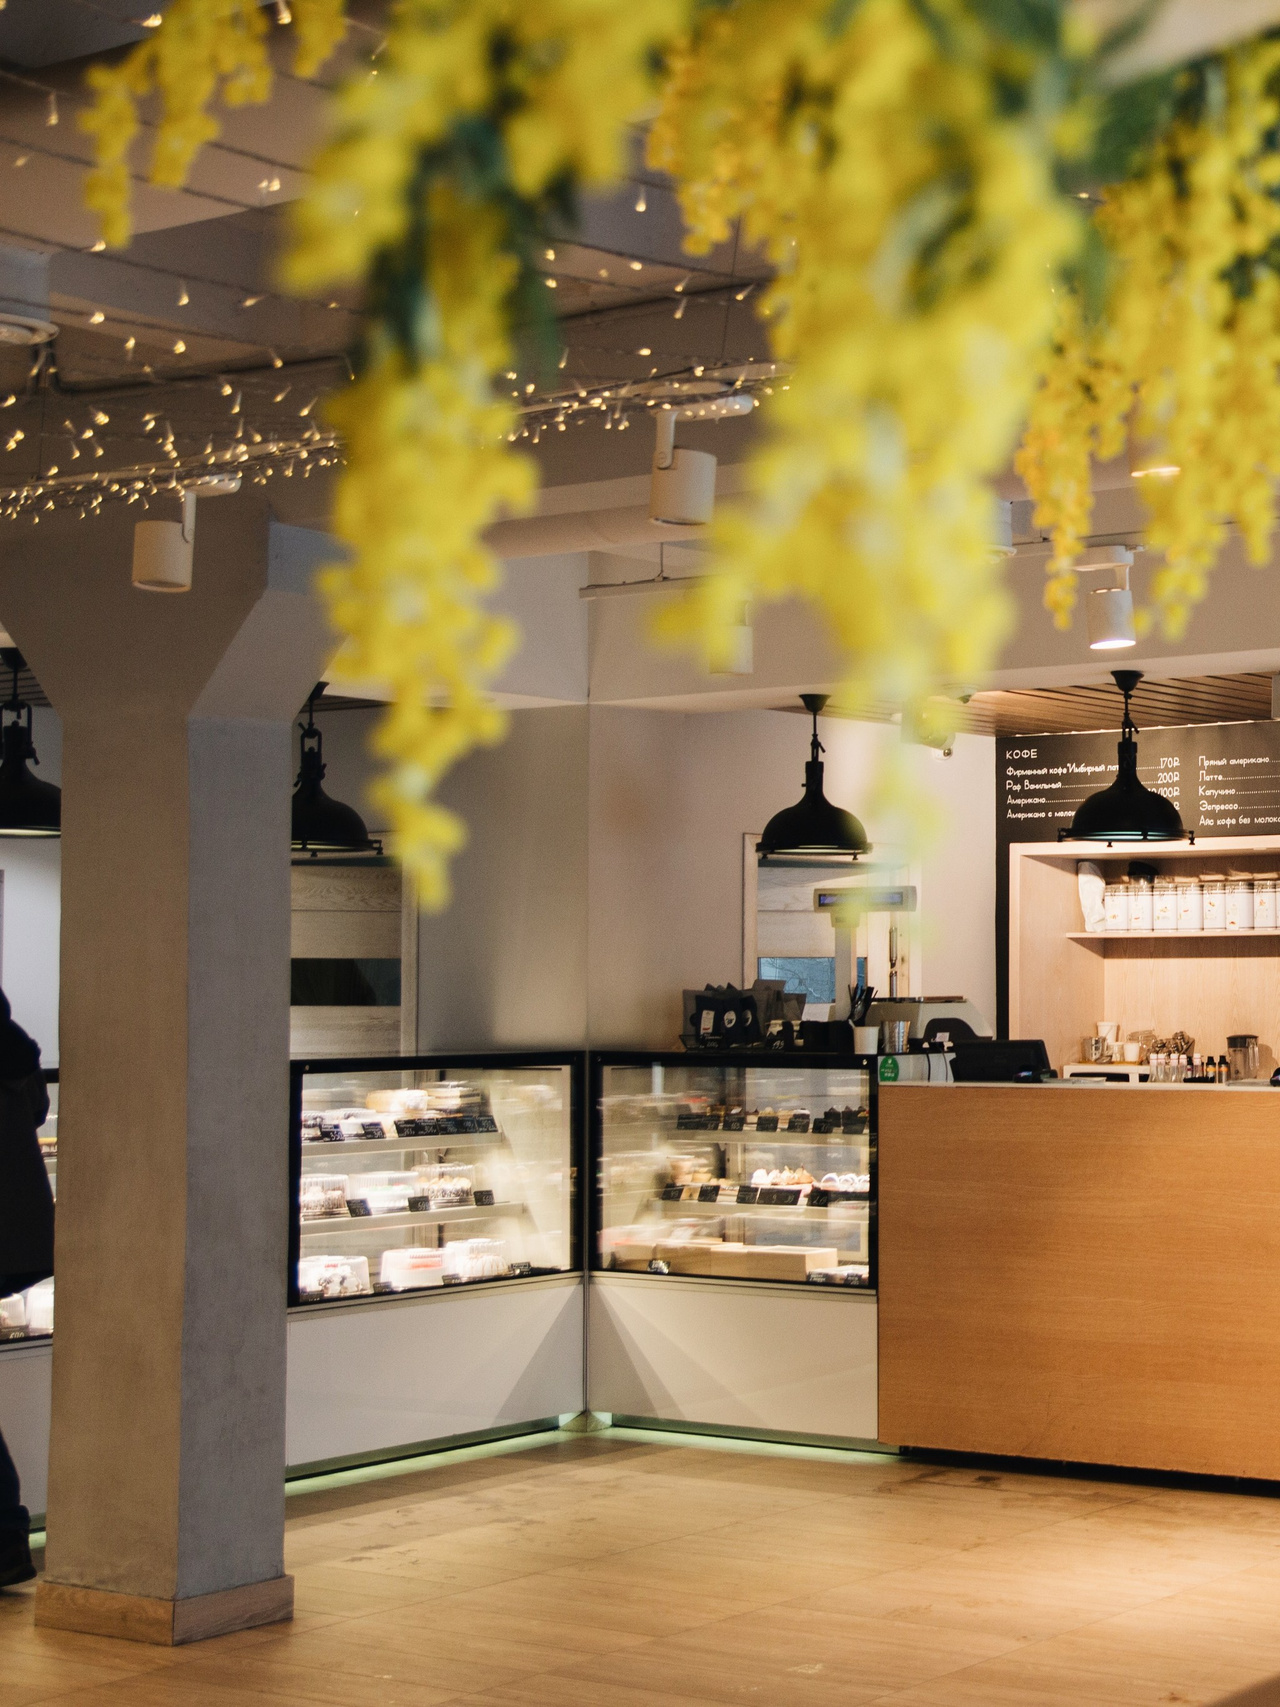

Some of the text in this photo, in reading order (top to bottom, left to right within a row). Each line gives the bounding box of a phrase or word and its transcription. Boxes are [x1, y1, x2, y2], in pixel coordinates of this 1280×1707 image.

[1005, 748, 1039, 760] КОФЕ
[1198, 755, 1227, 769] Пряный
[1229, 756, 1270, 768] американо
[1006, 766, 1048, 779] Фирменный
[1049, 767, 1067, 777] кофе
[1199, 770, 1223, 782] Латте
[1005, 779, 1022, 792] Раф
[1024, 779, 1062, 790] Ванильный
[1198, 785, 1236, 798] Капучино
[1006, 794, 1046, 807] Американо
[1199, 800, 1239, 813] Эспрессо
[1006, 808, 1046, 821] Американо
[1199, 815, 1215, 826] Айс
[1216, 816, 1236, 828] кофе
[1238, 814, 1251, 825] без
